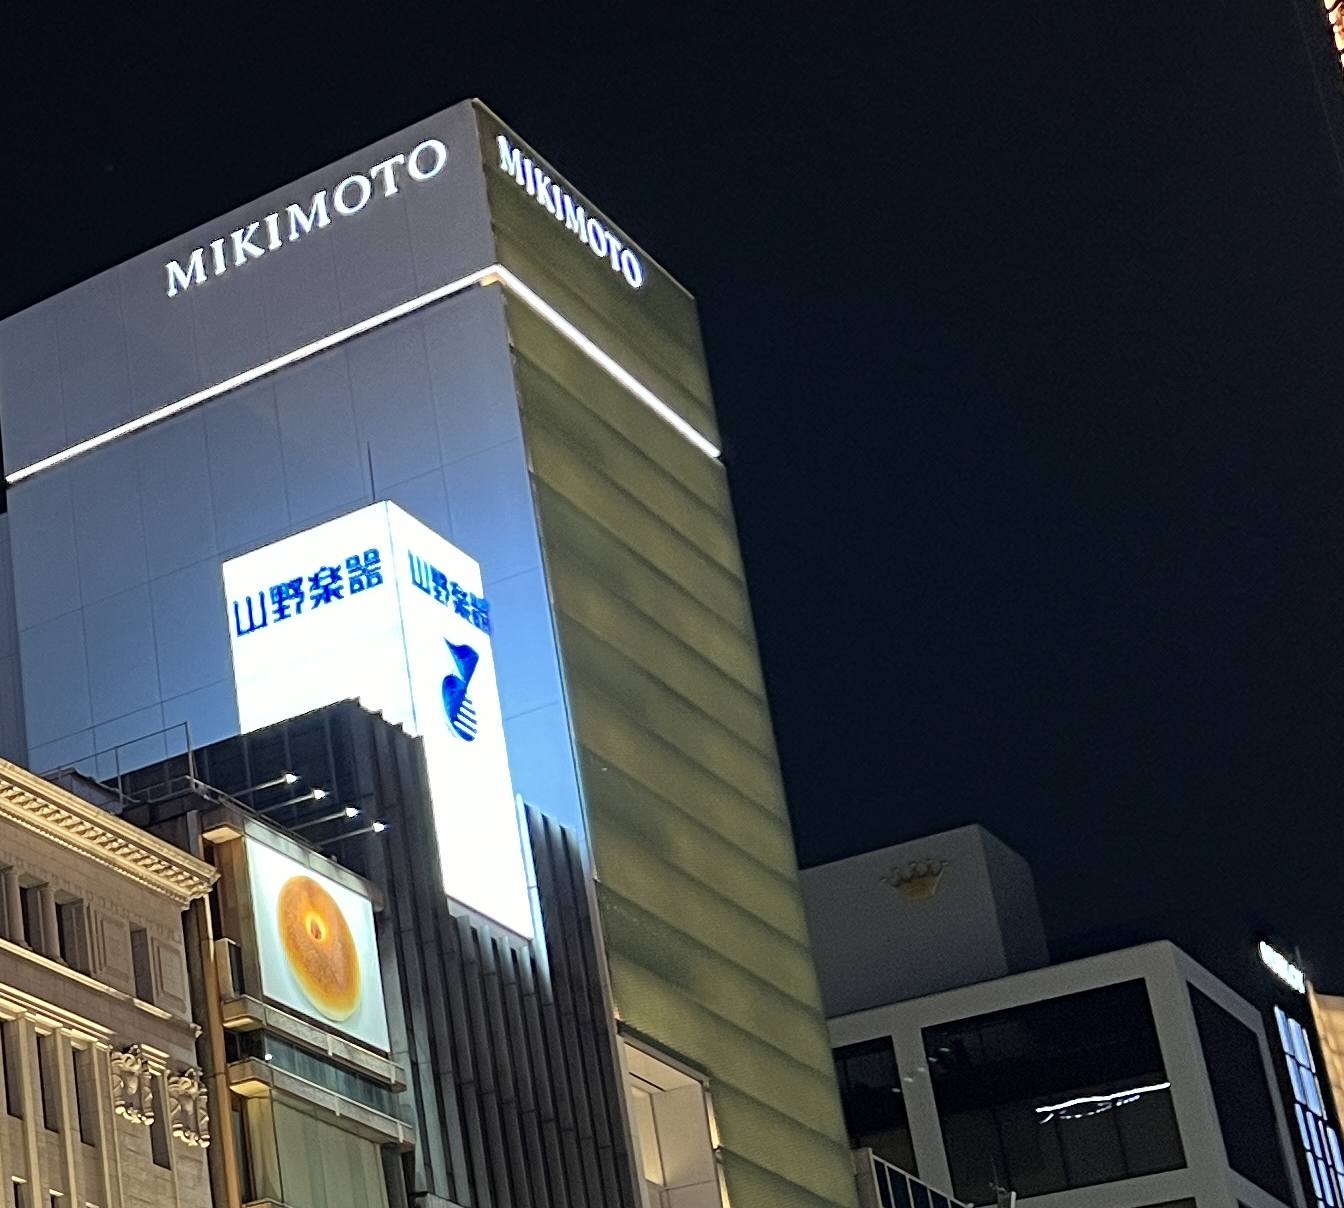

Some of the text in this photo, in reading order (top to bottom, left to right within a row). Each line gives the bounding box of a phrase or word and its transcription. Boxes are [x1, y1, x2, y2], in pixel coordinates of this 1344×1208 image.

[164, 137, 450, 298] MIKIMOTO
[495, 133, 645, 290] MIKIMOTO
[232, 547, 385, 638] 山野楽器
[407, 548, 495, 637] 山野楽器
